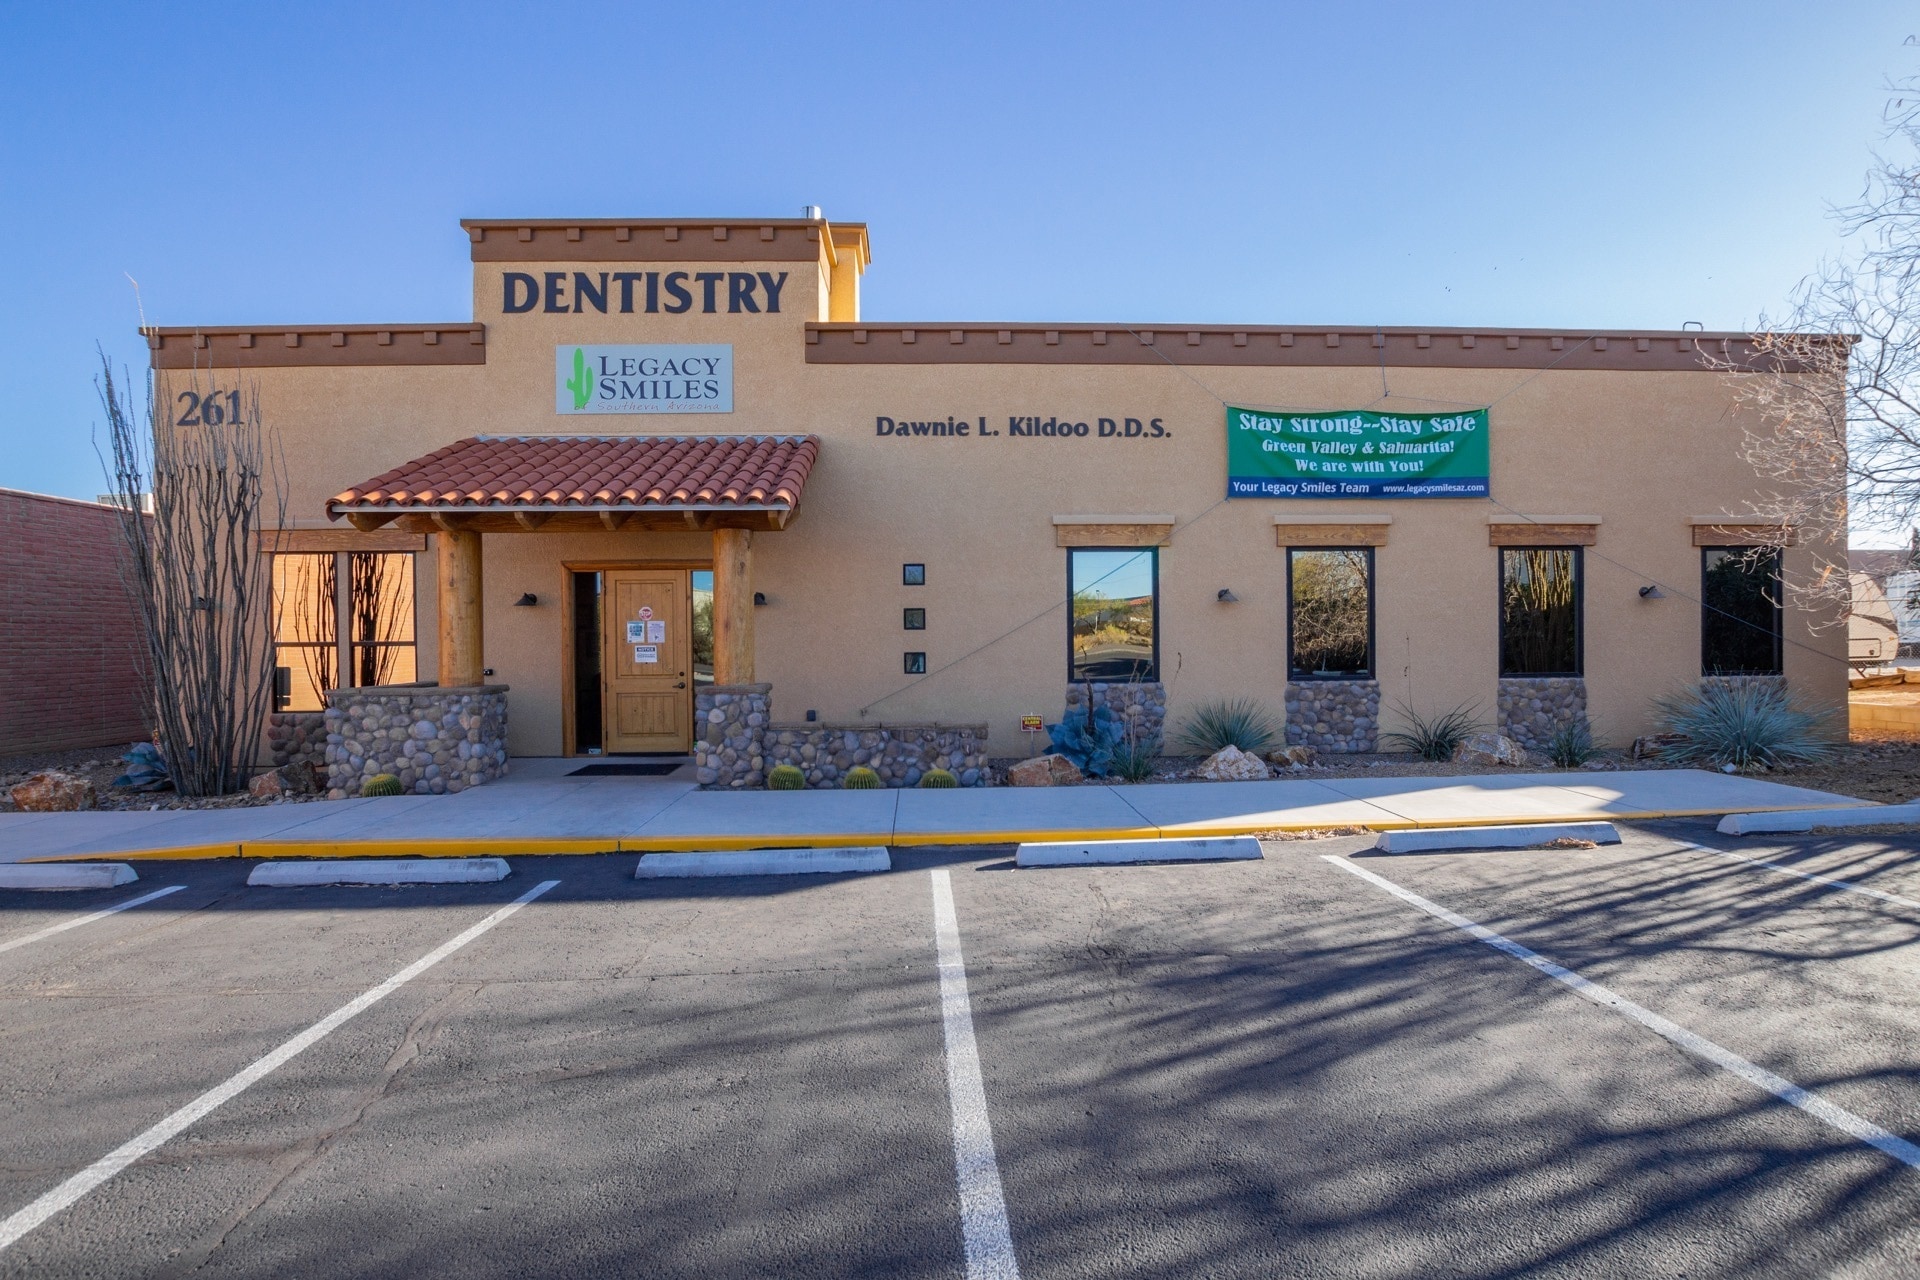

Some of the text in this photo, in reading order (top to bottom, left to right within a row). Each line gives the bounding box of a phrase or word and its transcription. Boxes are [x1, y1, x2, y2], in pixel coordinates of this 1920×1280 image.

[502, 271, 788, 314] DENTISTRY
[598, 355, 721, 376] LEGACY
[600, 378, 719, 400] SMILES
[177, 389, 244, 426] 261
[597, 401, 659, 411] Southern
[667, 401, 720, 411] Arizona
[876, 416, 1171, 438] Dawnie L. Kildoo D.D.S.
[1239, 413, 1283, 434] Stay
[1262, 439, 1454, 456] Green Valley & Sahuarita!
[1295, 459, 1424, 473] We are with You!
[1233, 482, 1369, 495] Your Legacy Smiles Team
[1383, 484, 1484, 494] www.legacysmilesaz.com
